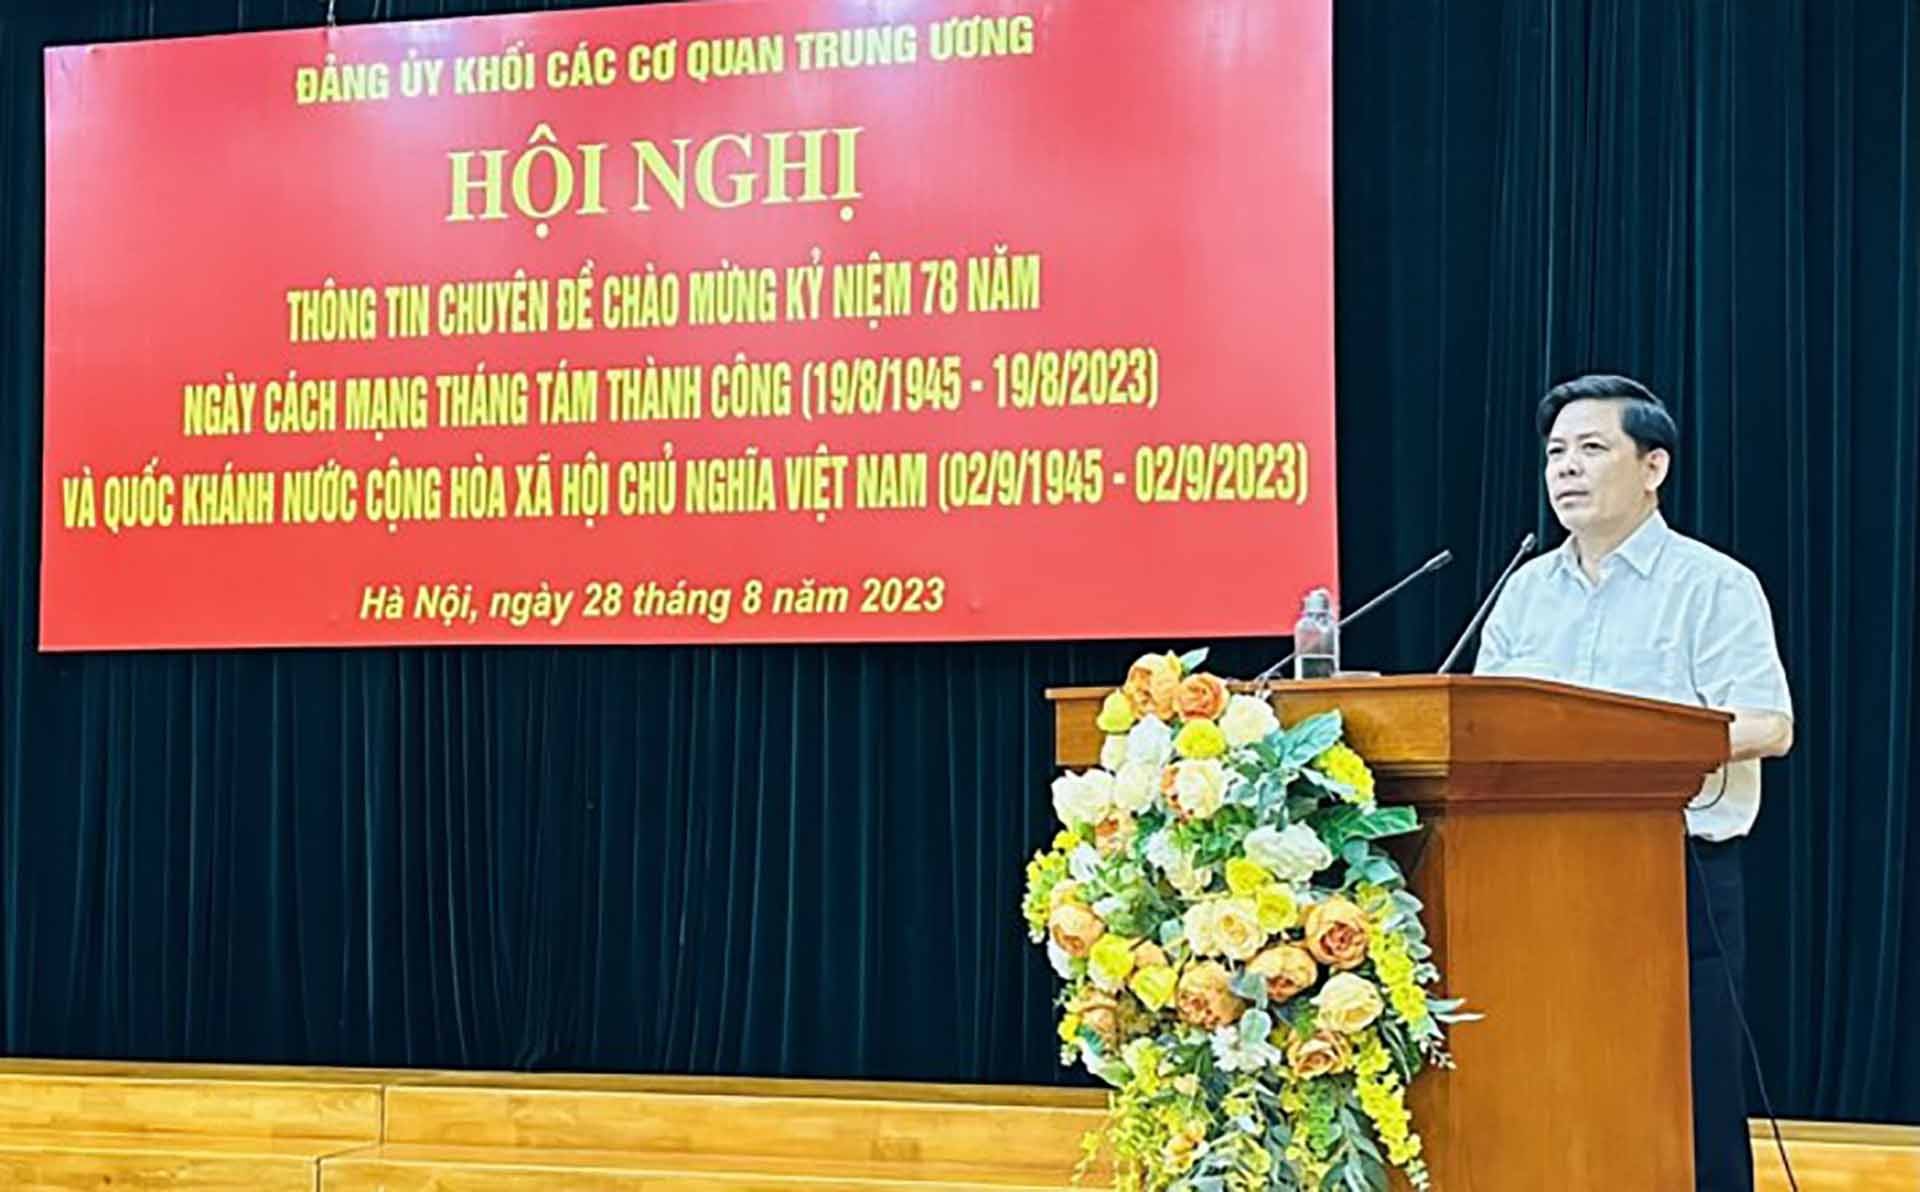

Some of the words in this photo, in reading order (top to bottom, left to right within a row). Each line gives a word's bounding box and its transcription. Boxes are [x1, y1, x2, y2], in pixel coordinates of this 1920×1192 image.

[296, 54, 388, 104] ĐẢNG
[400, 48, 442, 96] ỦY
[456, 41, 534, 94] KHỐI
[548, 42, 616, 88] CÁC
[629, 40, 676, 82] CƠ
[688, 36, 783, 80] QUAN
[796, 26, 916, 70] TRUNG
[930, 16, 1033, 60] ƯƠNG
[446, 123, 608, 239] HỘI
[631, 126, 864, 221] NGHỊ
[288, 278, 376, 342] THÔNG
[386, 286, 429, 336] TIN
[438, 270, 548, 335] CHUYÊN
[558, 258, 594, 330] ĐỀ
[603, 262, 679, 328] CHÀO
[689, 257, 776, 324] MỪNG
[786, 246, 824, 320] KỶ
[834, 251, 911, 328] NIỆM
[921, 260, 957, 314] 78
[968, 244, 1040, 312] NĂM
[184, 375, 256, 436] NGÀY
[264, 371, 336, 433] CÁCH
[345, 378, 428, 440] MẠNG
[436, 364, 528, 428] THÁNG
[536, 361, 598, 424] TÁM
[607, 356, 701, 421] THÀNH
[711, 352, 791, 418] CÔNG
[802, 356, 961, 420] (19/8/1945
[971, 380, 984, 392] -
[994, 348, 1159, 408] 19/8/2023)
[64, 467, 95, 528] VÀ
[103, 458, 174, 532] QUỐC
[182, 464, 274, 526] KHÁNH
[283, 462, 357, 522] NƯỚC
[366, 458, 440, 532] CỘNG
[450, 454, 506, 518] HÒA
[514, 454, 552, 516] XÃ
[561, 452, 608, 526] HỘI
[618, 442, 676, 514] CHỦ
[686, 448, 776, 512] NGHĨA
[786, 445, 848, 522] VIỆT
[856, 453, 927, 508] NAM
[939, 446, 1103, 512] (02/9/1945
[1113, 472, 1126, 484] -
[1136, 442, 1308, 503] 02/9/2023)
[360, 587, 404, 620] Hà
[414, 584, 478, 626] Nội,
[490, 582, 572, 627] ngày
[583, 582, 623, 616] 28
[632, 581, 731, 624] tháng
[742, 580, 762, 614] 8
[772, 579, 848, 613] năm
[861, 577, 945, 612] 2023
